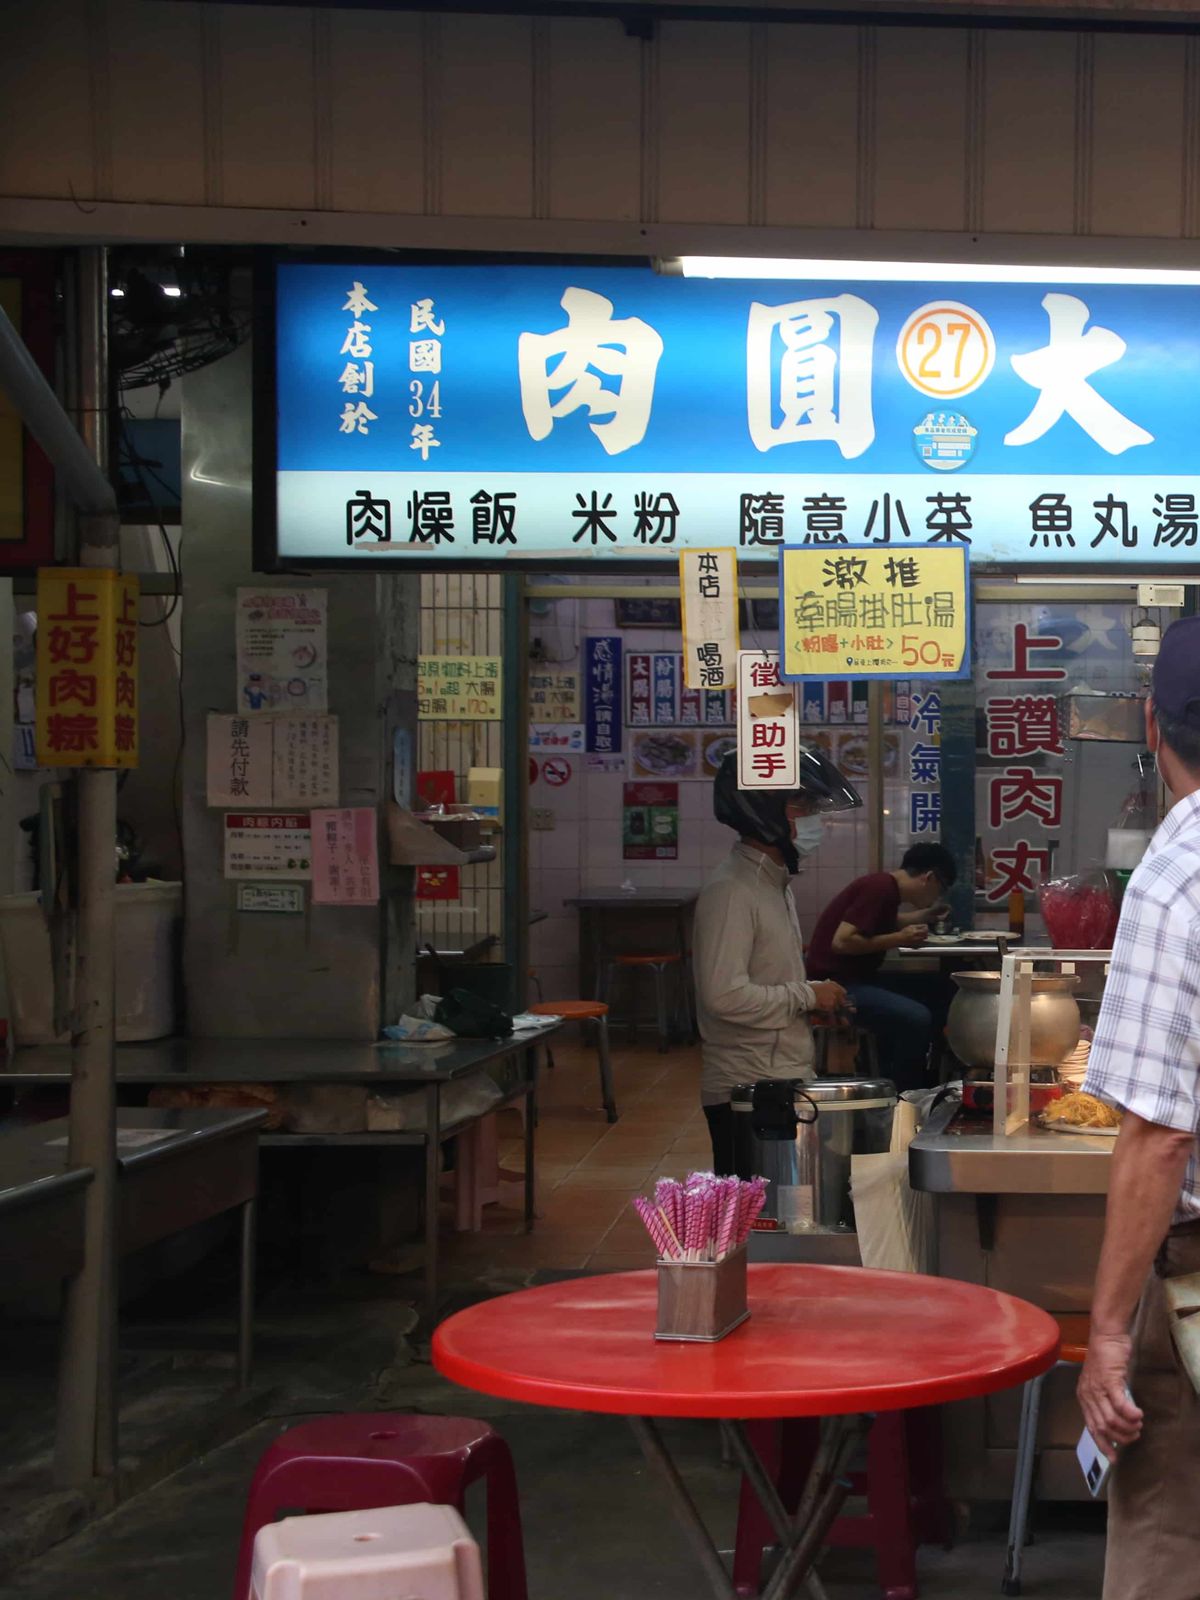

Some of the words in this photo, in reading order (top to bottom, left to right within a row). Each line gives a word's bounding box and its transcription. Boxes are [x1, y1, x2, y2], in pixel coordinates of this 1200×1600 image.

[338, 281, 378, 435] 本店創於
[408, 298, 445, 461] 民國34年
[517, 286, 880, 460] 肉圓
[916, 321, 969, 377] 27
[346, 489, 519, 546] 肉燥飯
[572, 491, 681, 544] 米粉
[738, 491, 974, 546] 隨意小菜
[1028, 492, 1199, 549] 魚丸湯
[823, 556, 921, 590] 激推
[47, 582, 99, 752] 上好肉粽
[115, 587, 137, 752] 上好肉粽
[795, 591, 955, 632] 牽腸掛肚湯
[231, 720, 250, 796] 請先付款
[750, 661, 787, 778] 徵助手
[986, 622, 1067, 903] 上讚肉丸
